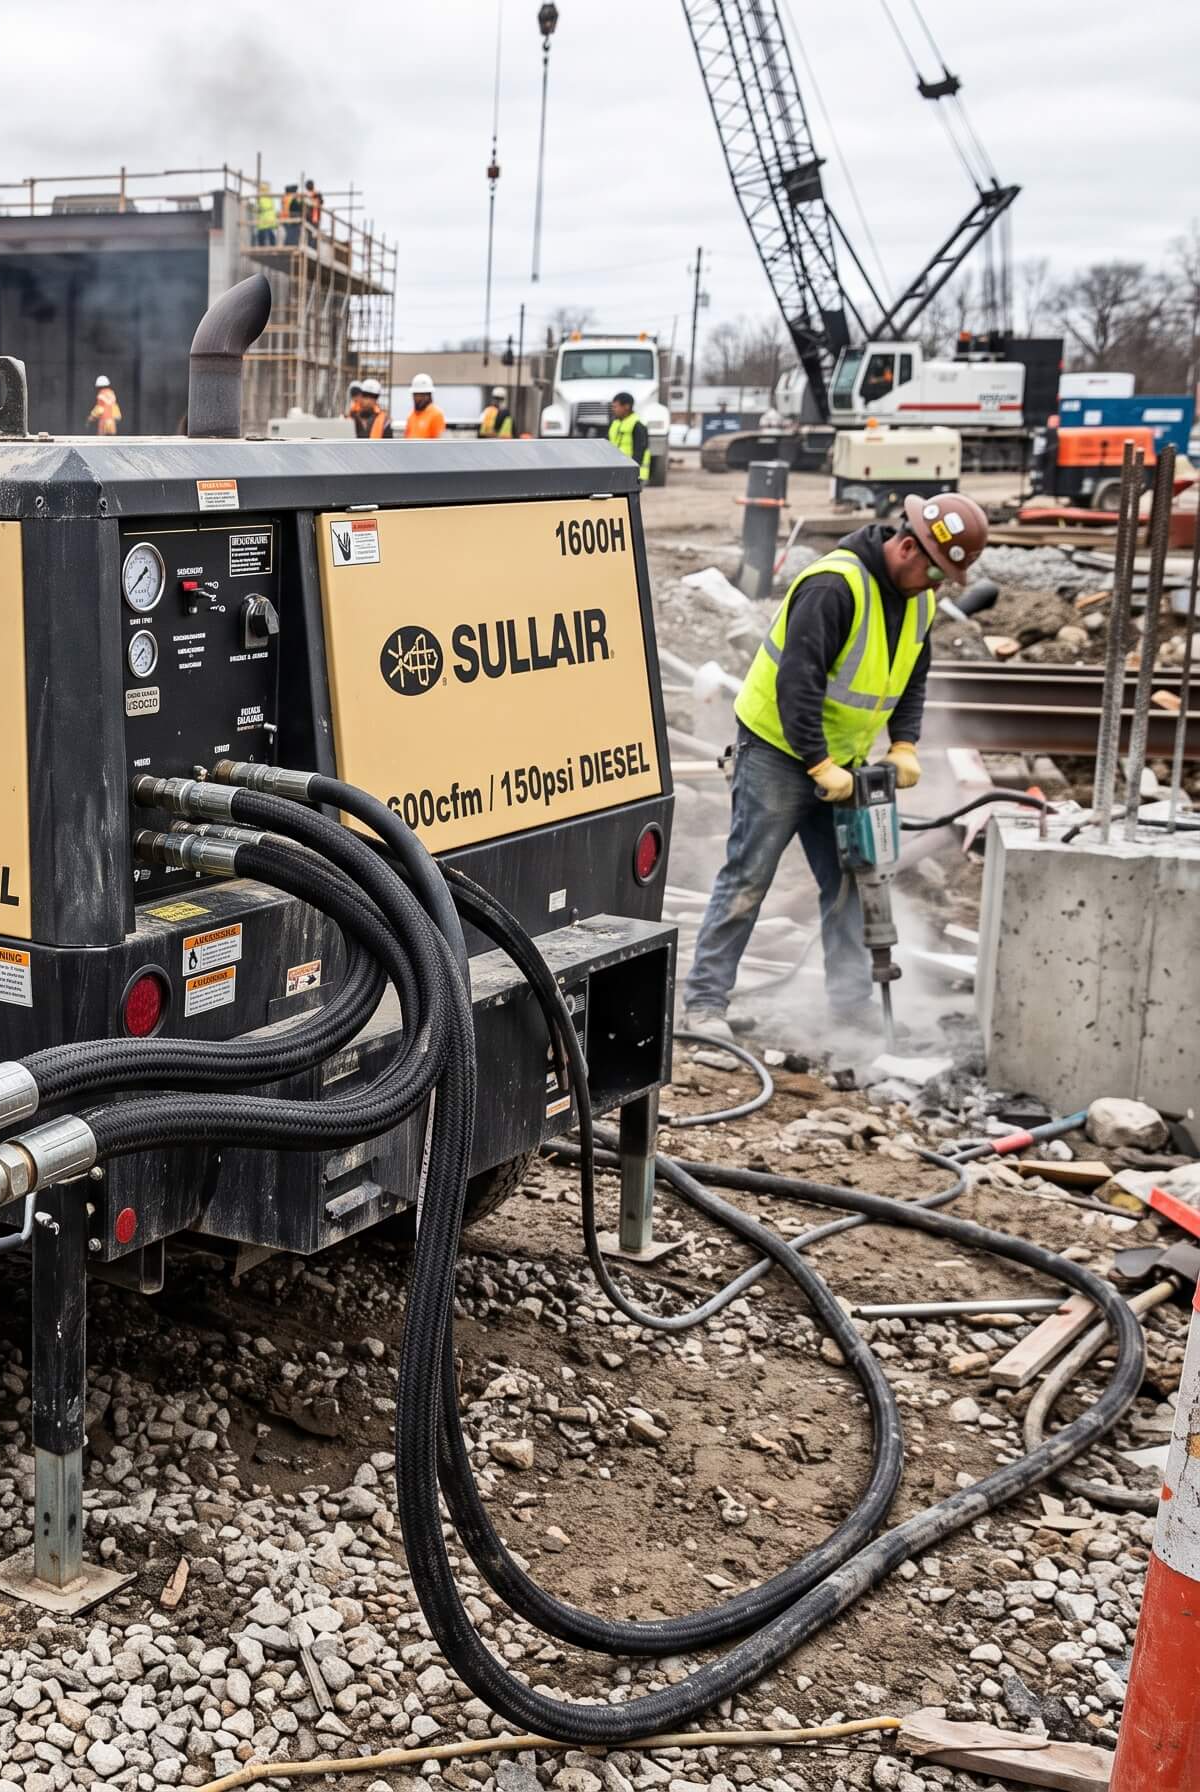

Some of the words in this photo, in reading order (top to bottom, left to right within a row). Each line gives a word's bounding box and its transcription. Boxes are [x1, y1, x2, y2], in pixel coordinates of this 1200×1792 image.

[555, 517, 626, 556] 1600H
[452, 608, 609, 684] SULLAIR
[387, 782, 483, 831] 600cfm
[500, 758, 575, 806] 150psi
[579, 742, 650, 788] DIESEL
